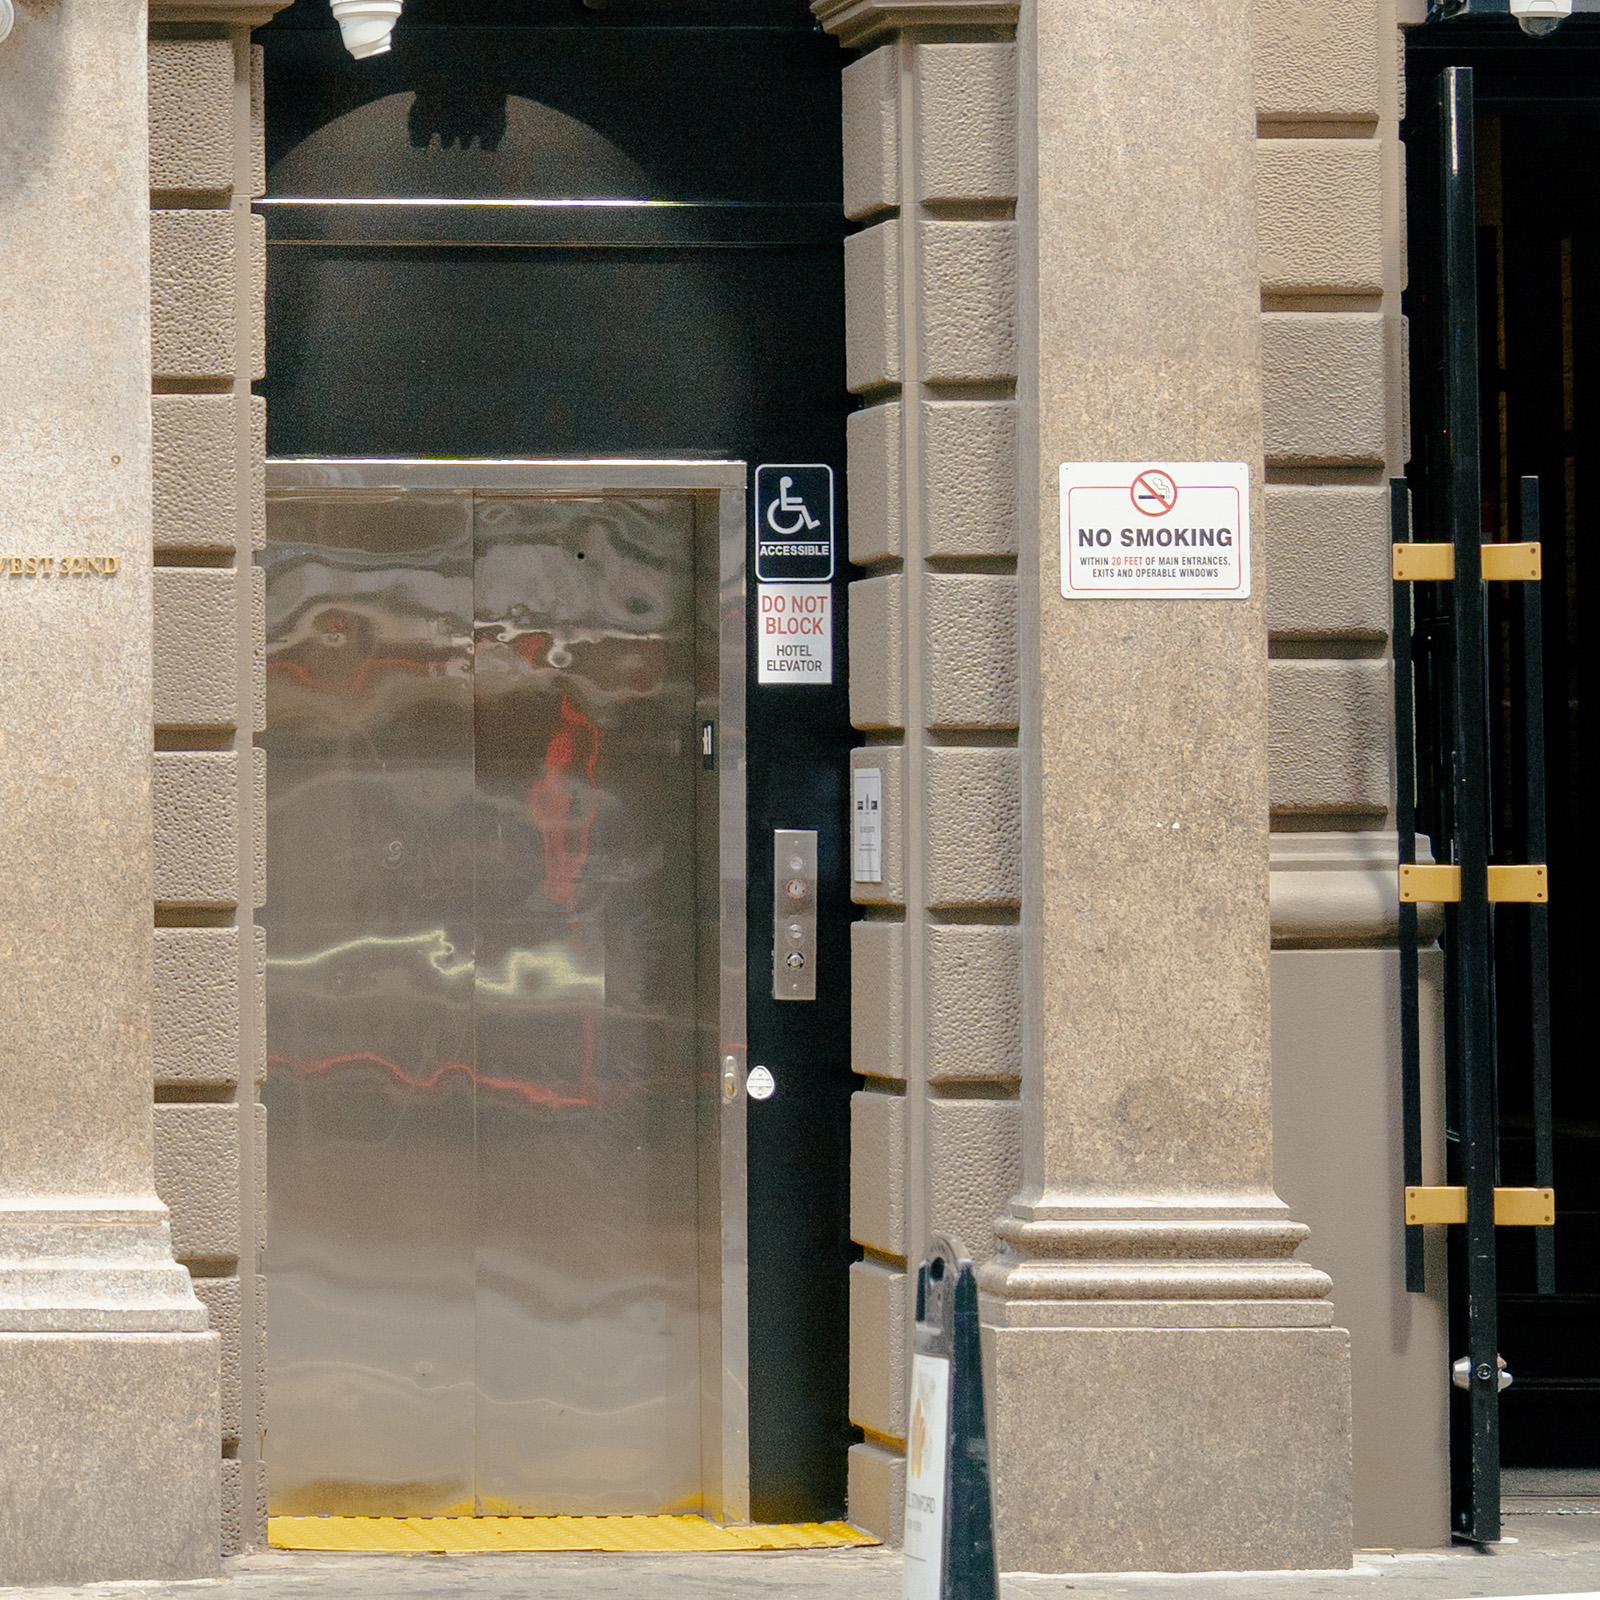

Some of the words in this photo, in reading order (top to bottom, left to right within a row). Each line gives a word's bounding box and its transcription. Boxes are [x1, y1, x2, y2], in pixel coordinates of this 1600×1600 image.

[1078, 528, 1112, 547] NO
[1120, 528, 1232, 547] SMOKING
[760, 545, 830, 556] ACCESSIBLE
[58, 556, 121, 575] 32ND
[1080, 557, 1109, 566] WITHIN
[1111, 557, 1122, 566] 20
[1124, 557, 1143, 566] FEET
[1145, 557, 1156, 566] OF
[1158, 557, 1179, 566] MAIN
[1182, 557, 1231, 567] ENTRANCES,
[1092, 568, 1115, 578] EXITS
[1117, 568, 1133, 578] AND
[1135, 568, 1177, 578] OPERABLE
[1179, 568, 1219, 578] WINDOWS
[762, 595, 786, 613] DO
[791, 595, 828, 613] NOT
[765, 617, 824, 635] BLOCK
[776, 644, 812, 657] HOTEL
[767, 660, 822, 672] ELEVATOR
